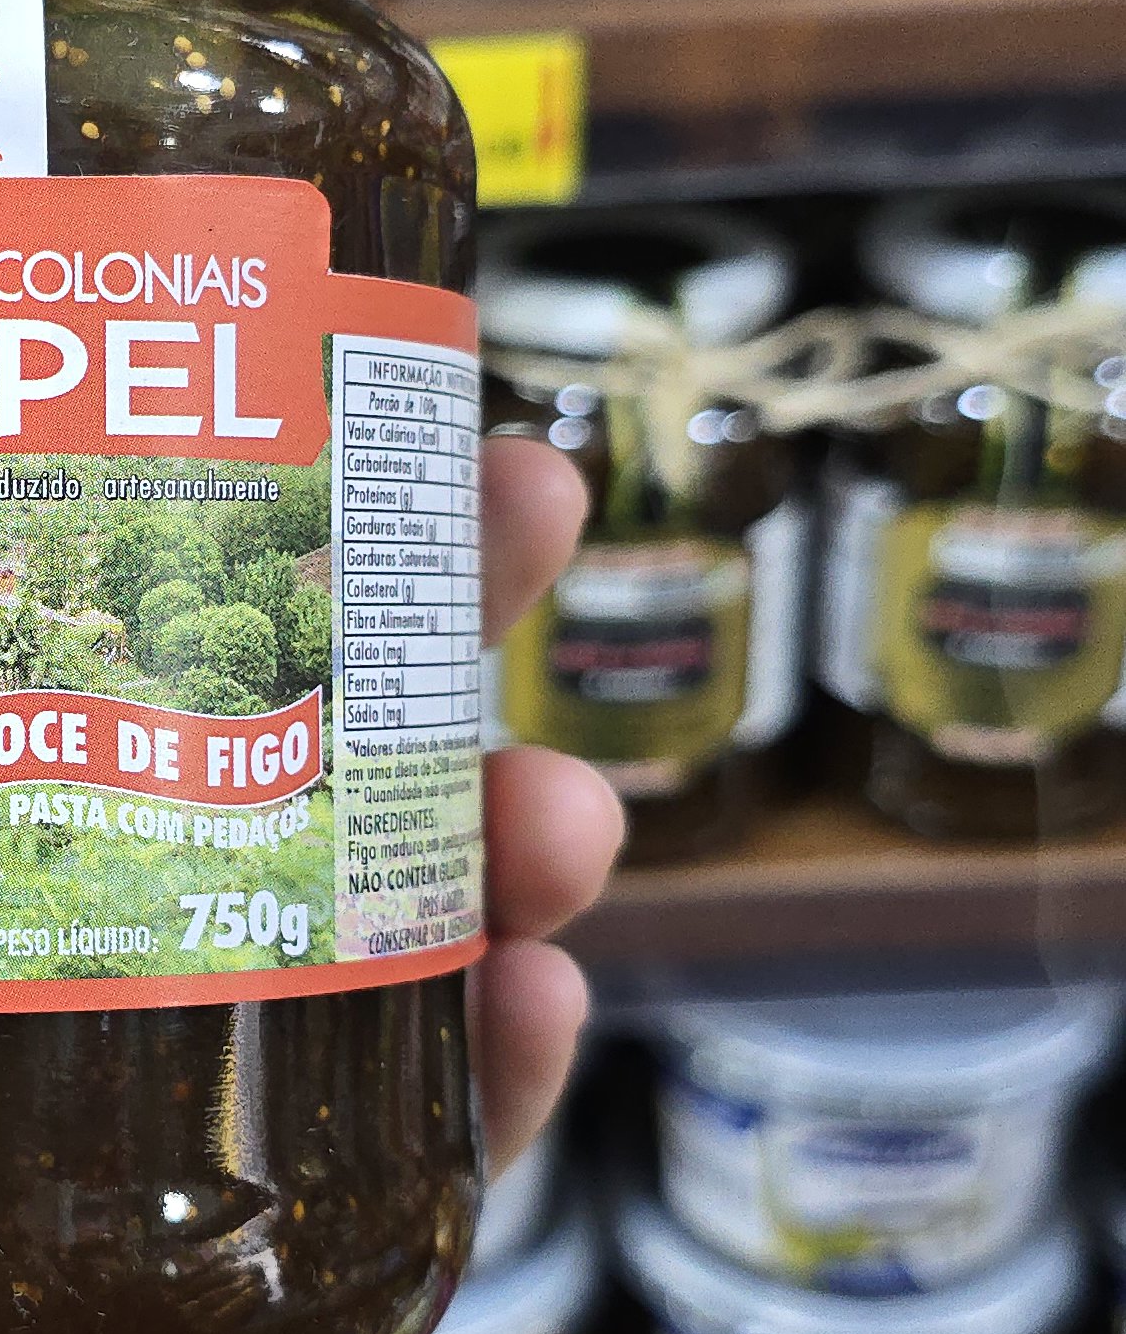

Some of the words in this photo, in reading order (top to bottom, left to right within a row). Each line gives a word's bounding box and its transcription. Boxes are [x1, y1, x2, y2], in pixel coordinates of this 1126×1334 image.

[368, 358, 443, 390] INFORMAÇÃO
[347, 420, 375, 441] Valor
[347, 452, 412, 475] Carboidratos
[103, 473, 280, 504] artesanalmente
[346, 483, 397, 505] Proteínas
[346, 515, 396, 536] Gorduras
[346, 547, 396, 567] Gorduras
[346, 578, 399, 599] Colesterol
[346, 608, 376, 630] Fibra
[383, 640, 406, 665] (mg)
[347, 672, 378, 693] Ferro
[381, 671, 404, 696] (mg)
[383, 701, 406, 727] (mg)
[117, 720, 180, 782] DE
[206, 721, 309, 788] FIGO
[345, 768, 364, 782] em
[367, 766, 392, 781] uma
[9, 791, 108, 830] PASTA
[118, 803, 184, 844] COM
[194, 796, 310, 853] PEDAÇOS
[347, 840, 376, 865] Figo
[348, 865, 382, 895] NÃO
[57, 920, 159, 957] LÍQUIDO:
[179, 890, 309, 957] 750g
